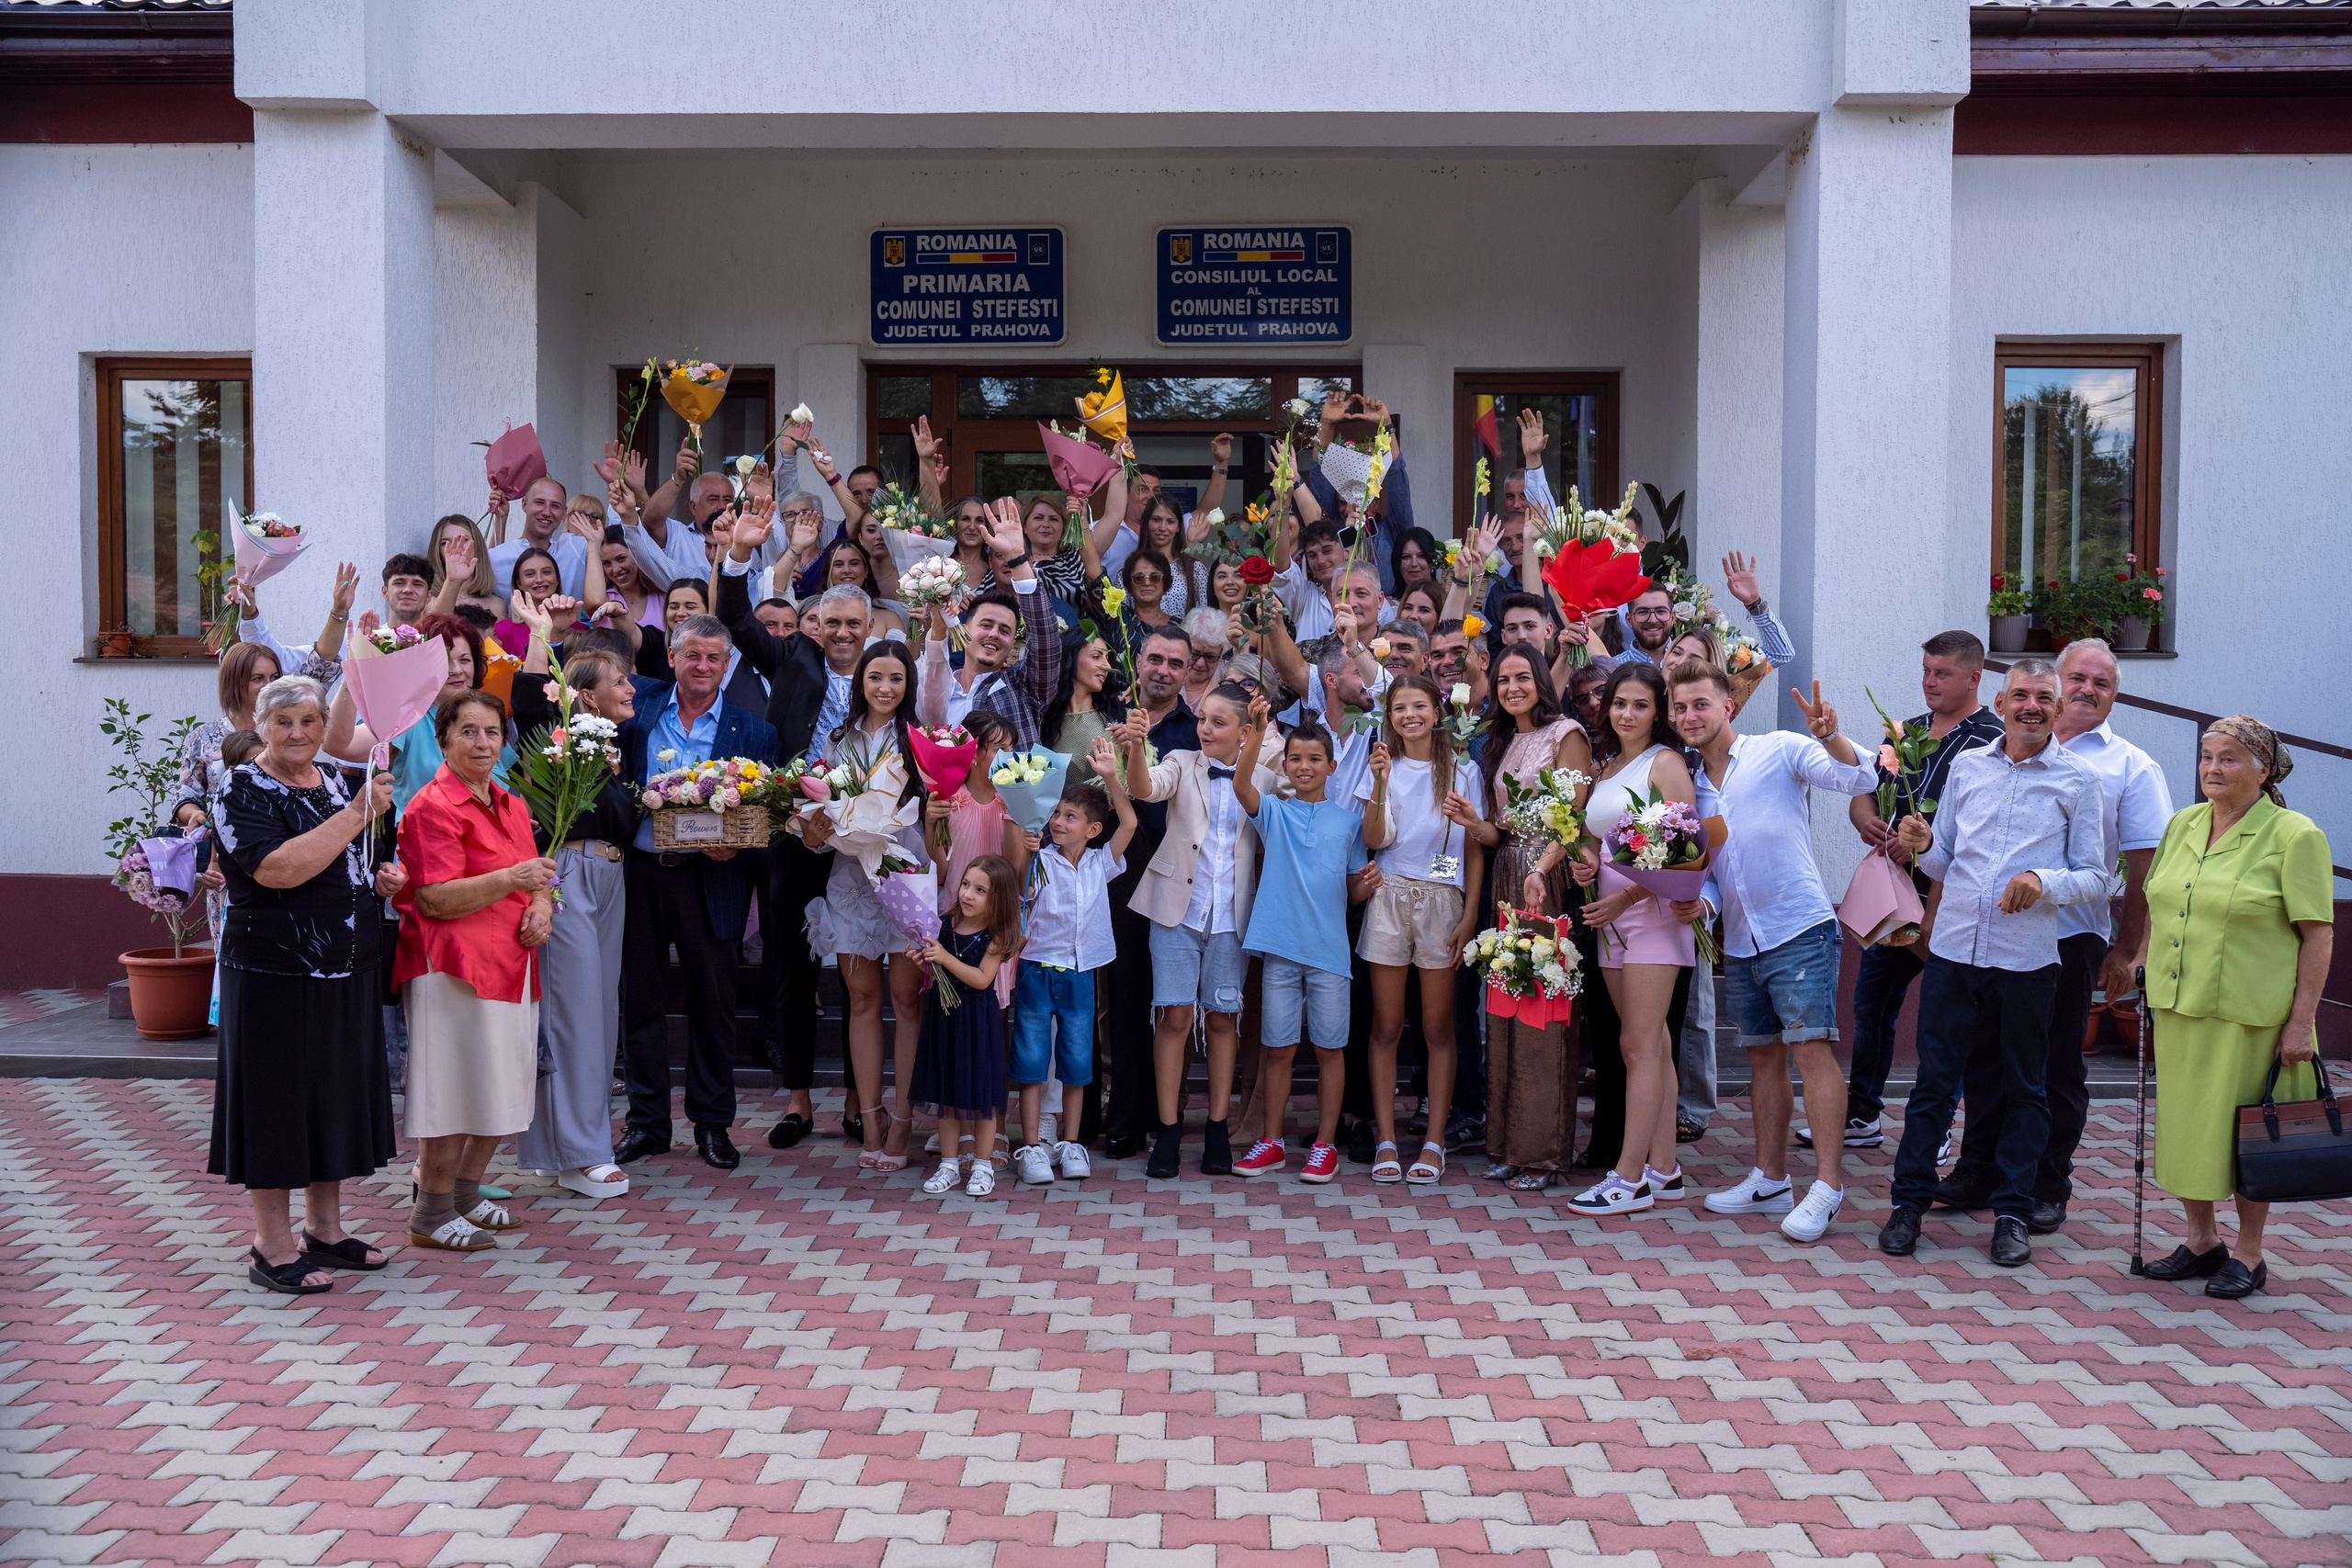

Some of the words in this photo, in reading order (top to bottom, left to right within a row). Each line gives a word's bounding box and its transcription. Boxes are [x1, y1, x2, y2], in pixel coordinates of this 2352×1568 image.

[917, 233, 1017, 251] ROMANIA
[1204, 232, 1306, 249] ROMANIA
[903, 274, 1031, 294] PRIMARIA
[1170, 270, 1272, 284] CONSILIUL
[1277, 269, 1339, 283] LOCAL
[1247, 287, 1262, 296] AL
[876, 299, 961, 320] COMUNEI
[972, 299, 1057, 319] STEFESTI
[1170, 299, 1251, 316] COMUNEI
[1257, 298, 1340, 315] STEFESTI
[884, 325, 961, 337] JUDETUL
[971, 324, 1051, 337] PRAHOVA
[1170, 324, 1249, 336] JUDETUL
[1259, 322, 1339, 335] PRAHOVA
[682, 819, 718, 834] Flowers
